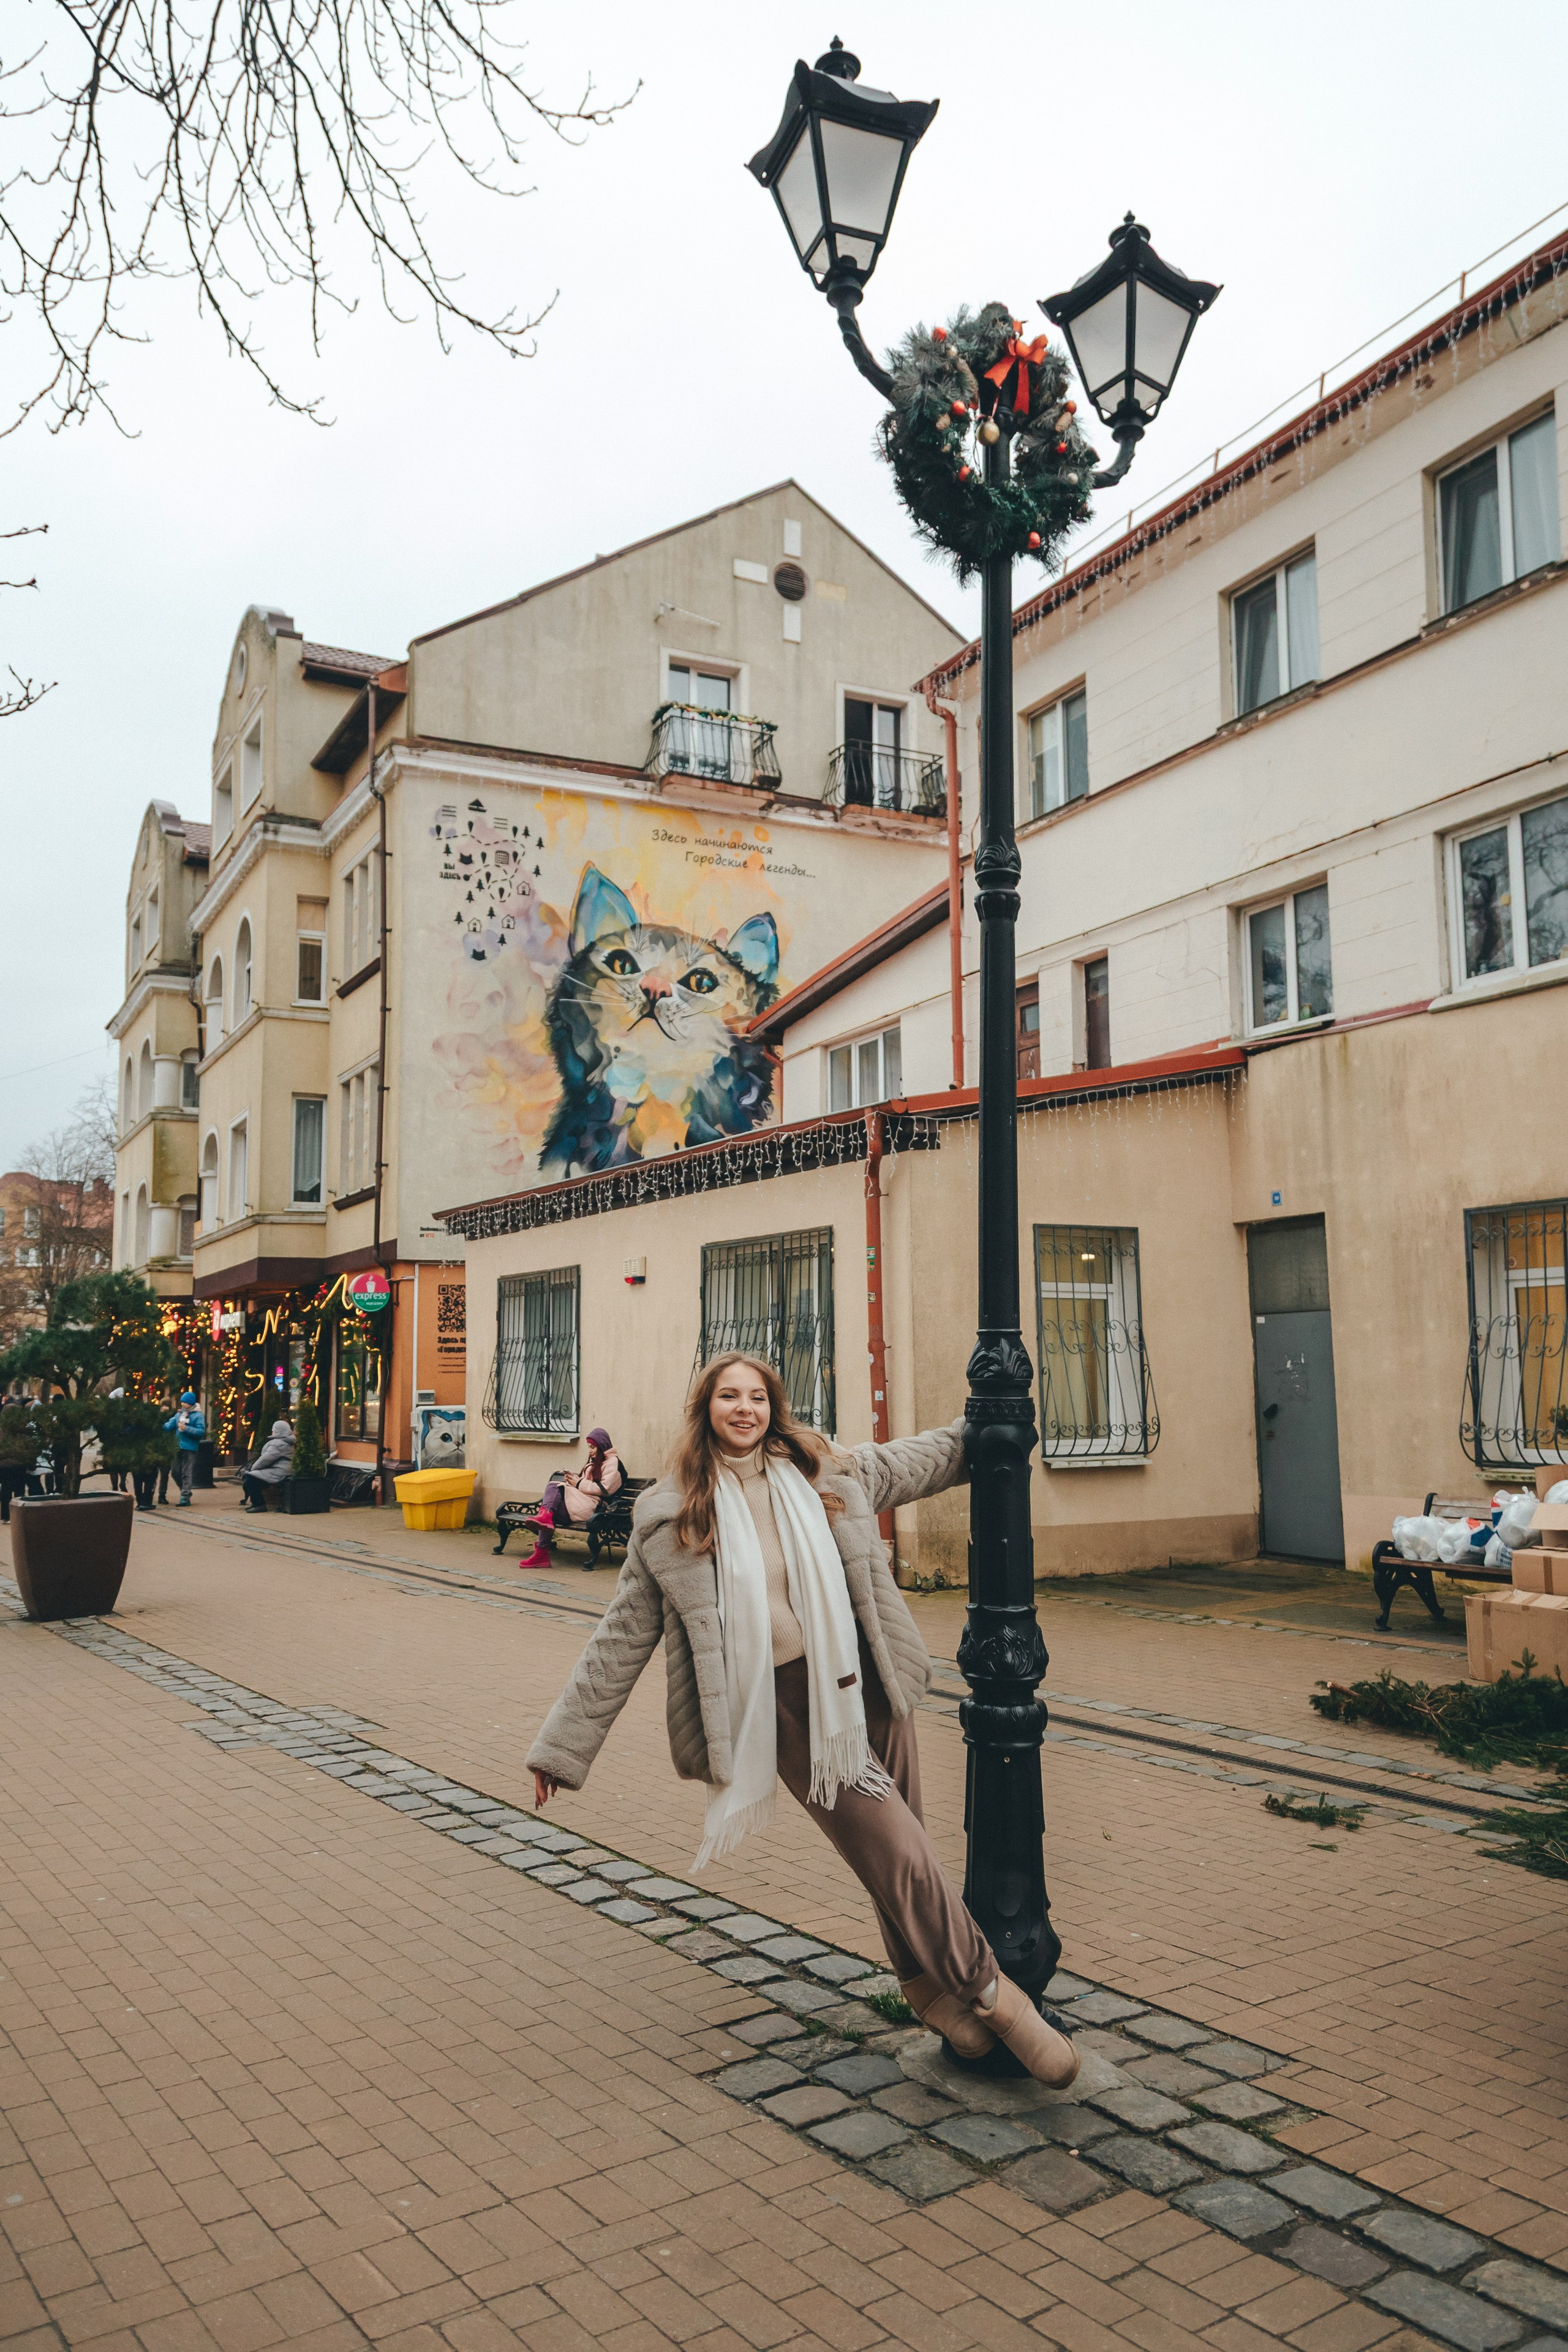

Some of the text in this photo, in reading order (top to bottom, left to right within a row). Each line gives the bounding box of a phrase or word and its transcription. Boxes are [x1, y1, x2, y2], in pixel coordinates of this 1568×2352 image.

[652, 829, 773, 855] Здесь начинаются
[685, 851, 816, 878] Городские легенды...
[439, 872, 461, 880] ЗДЕСЬ
[355, 1292, 386, 1302] express
